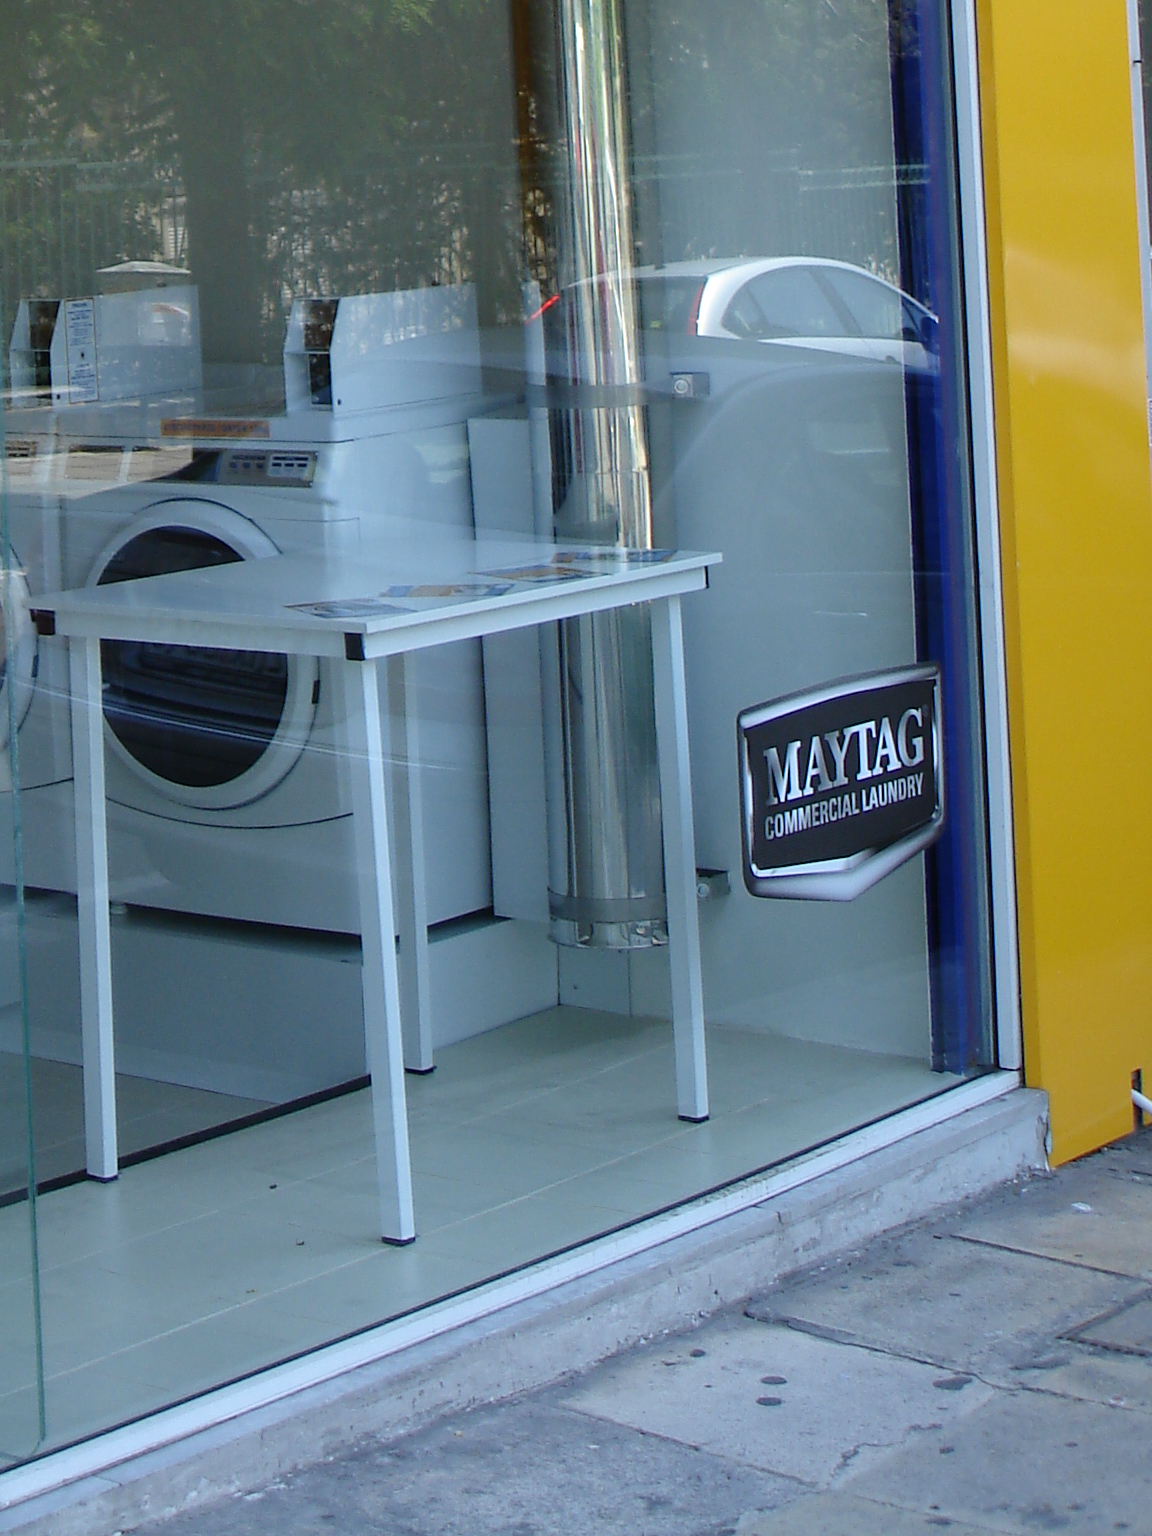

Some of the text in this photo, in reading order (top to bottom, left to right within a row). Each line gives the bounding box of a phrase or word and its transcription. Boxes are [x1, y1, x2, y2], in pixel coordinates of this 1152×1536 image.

[763, 708, 925, 807] MAYTAG
[765, 772, 924, 841] COMMERCIAL LAUNDRY
